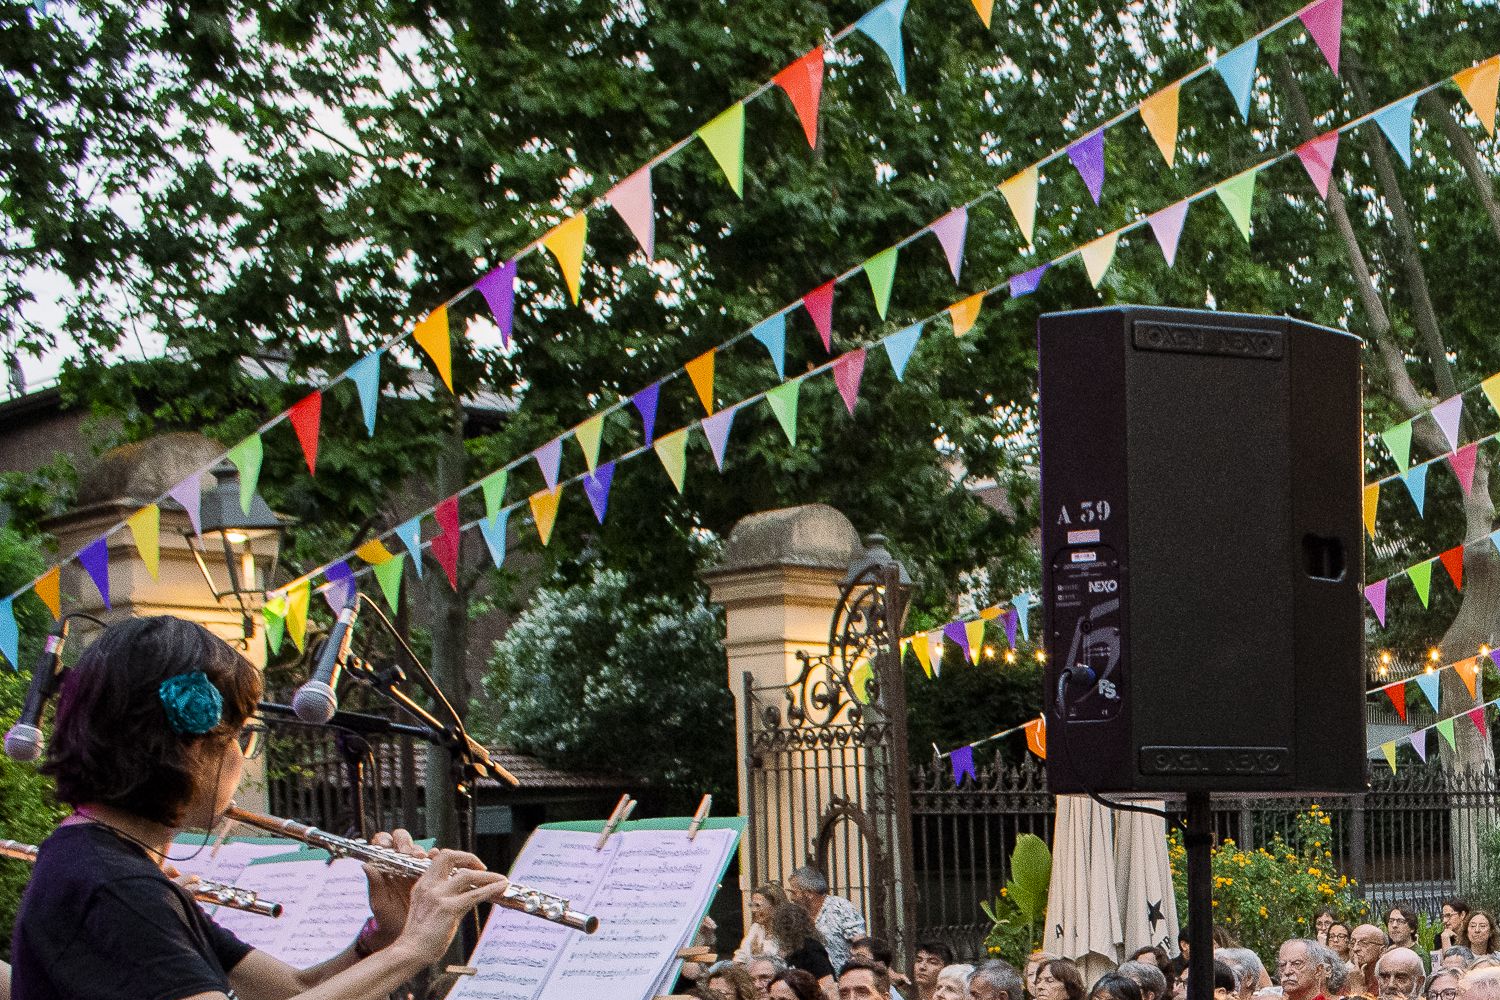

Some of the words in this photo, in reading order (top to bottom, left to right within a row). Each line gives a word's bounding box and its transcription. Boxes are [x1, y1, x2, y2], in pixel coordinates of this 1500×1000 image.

[1057, 505, 1072, 525] A
[1088, 579, 1118, 593] NEXO
[1098, 679, 1117, 699] PS
